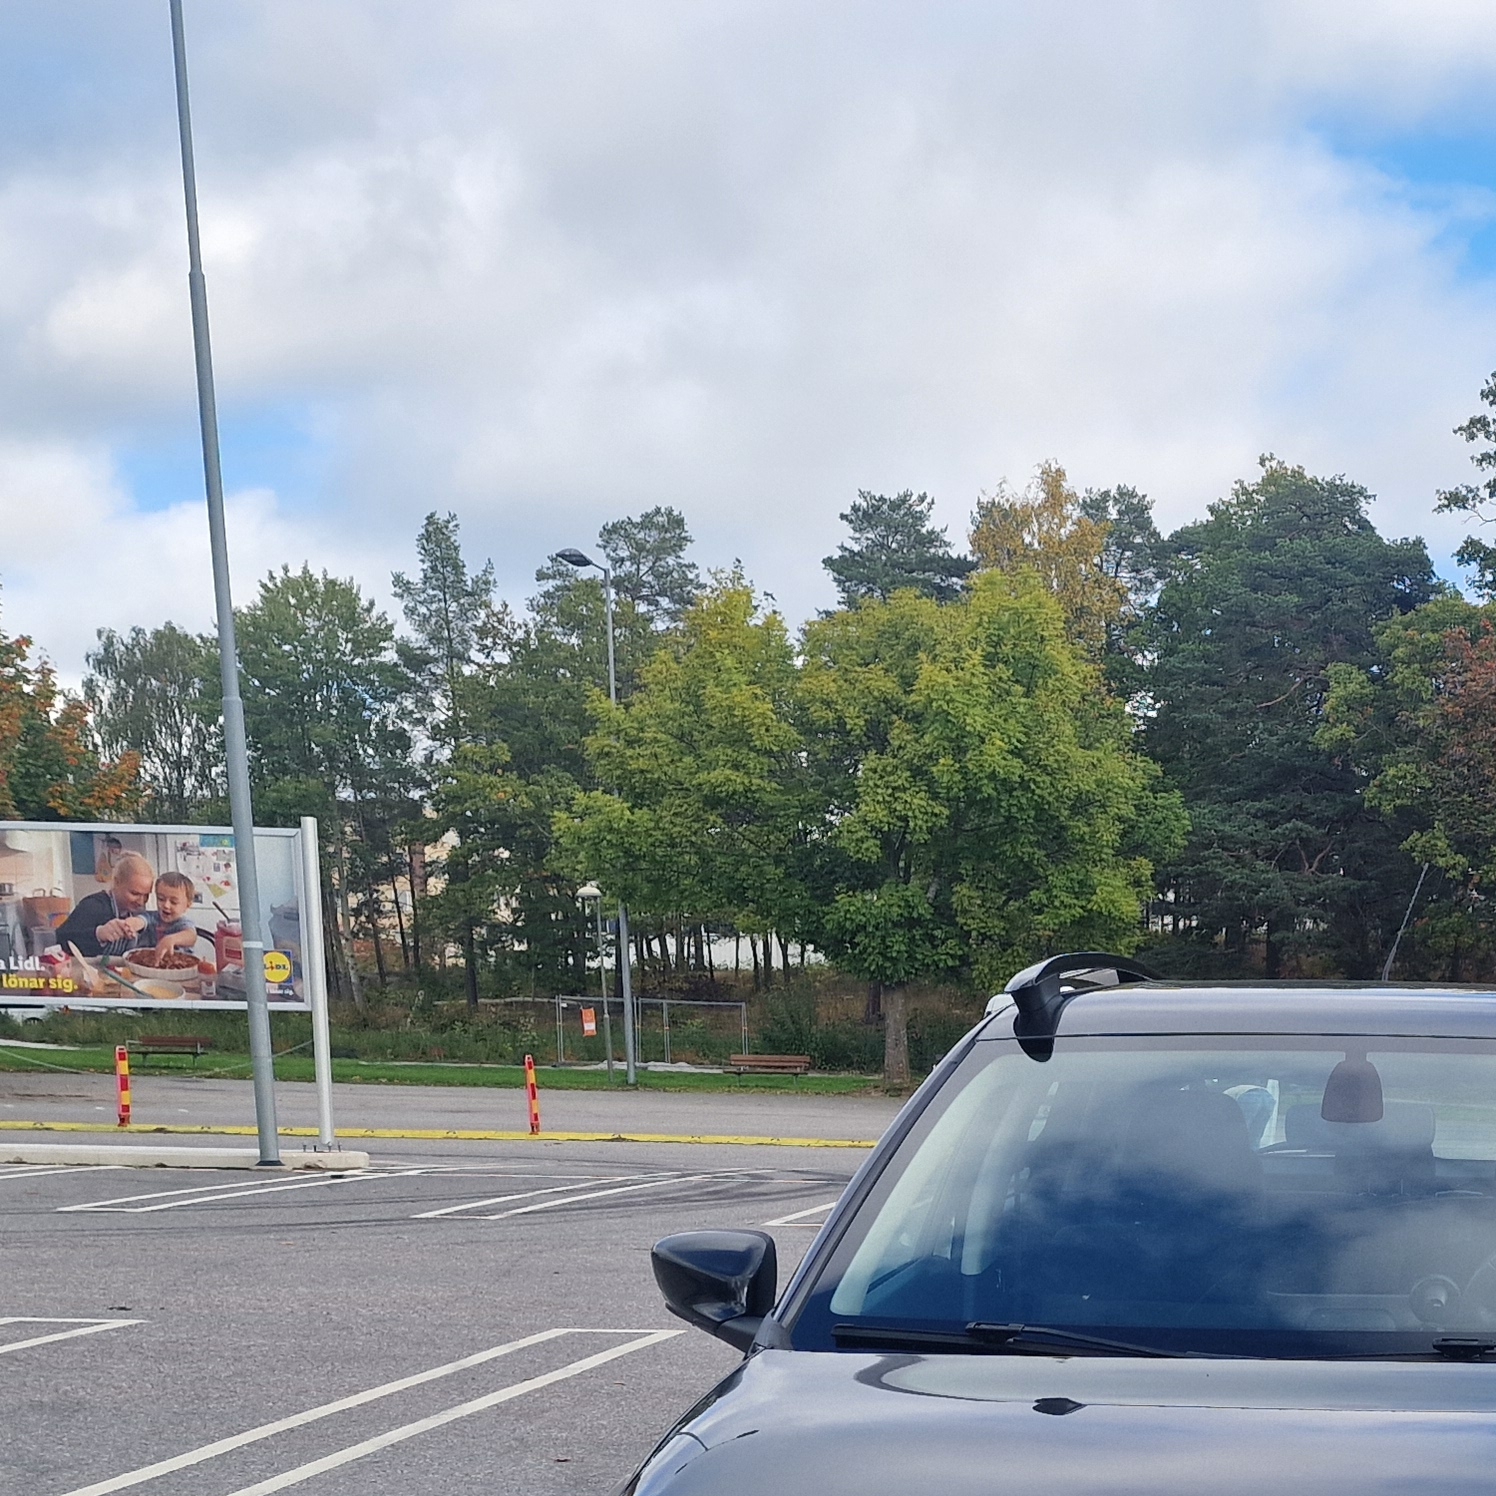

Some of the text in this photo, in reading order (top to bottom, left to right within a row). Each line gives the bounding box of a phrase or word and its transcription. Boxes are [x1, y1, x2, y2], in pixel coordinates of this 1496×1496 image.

[9, 956, 45, 970] Lidl.
[2, 973, 78, 993] lönar sig.
